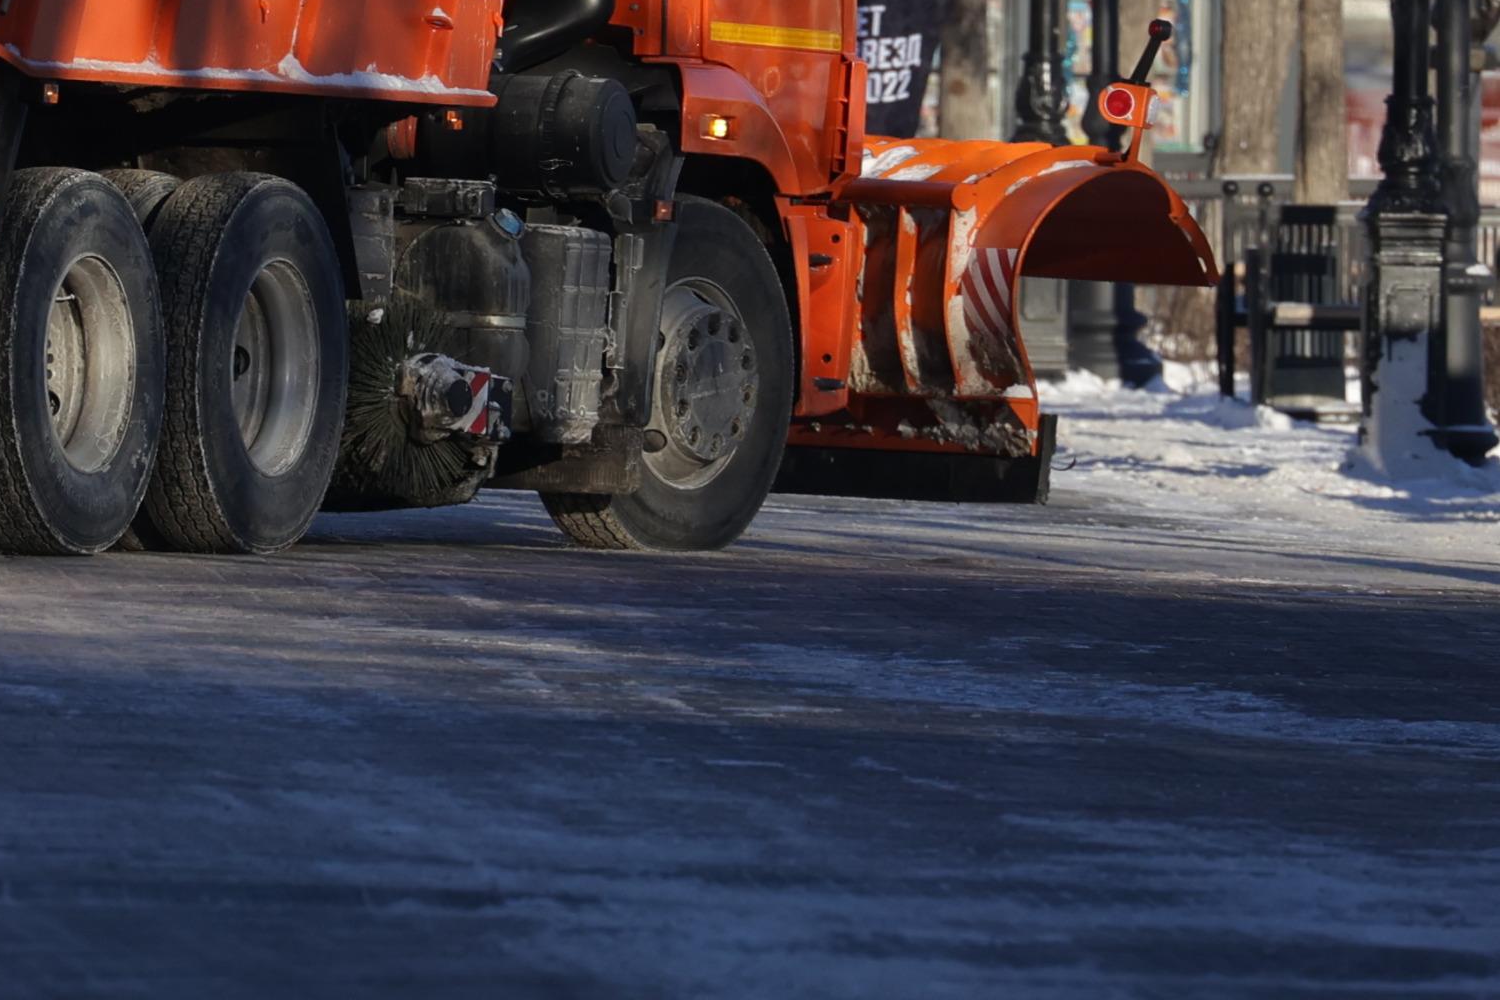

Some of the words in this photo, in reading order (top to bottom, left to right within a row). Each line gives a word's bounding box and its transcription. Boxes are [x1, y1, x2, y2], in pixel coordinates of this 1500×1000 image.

[857, 5, 886, 37] ЕТ
[857, 33, 922, 69] ВЕЗД
[865, 69, 912, 104] 022
